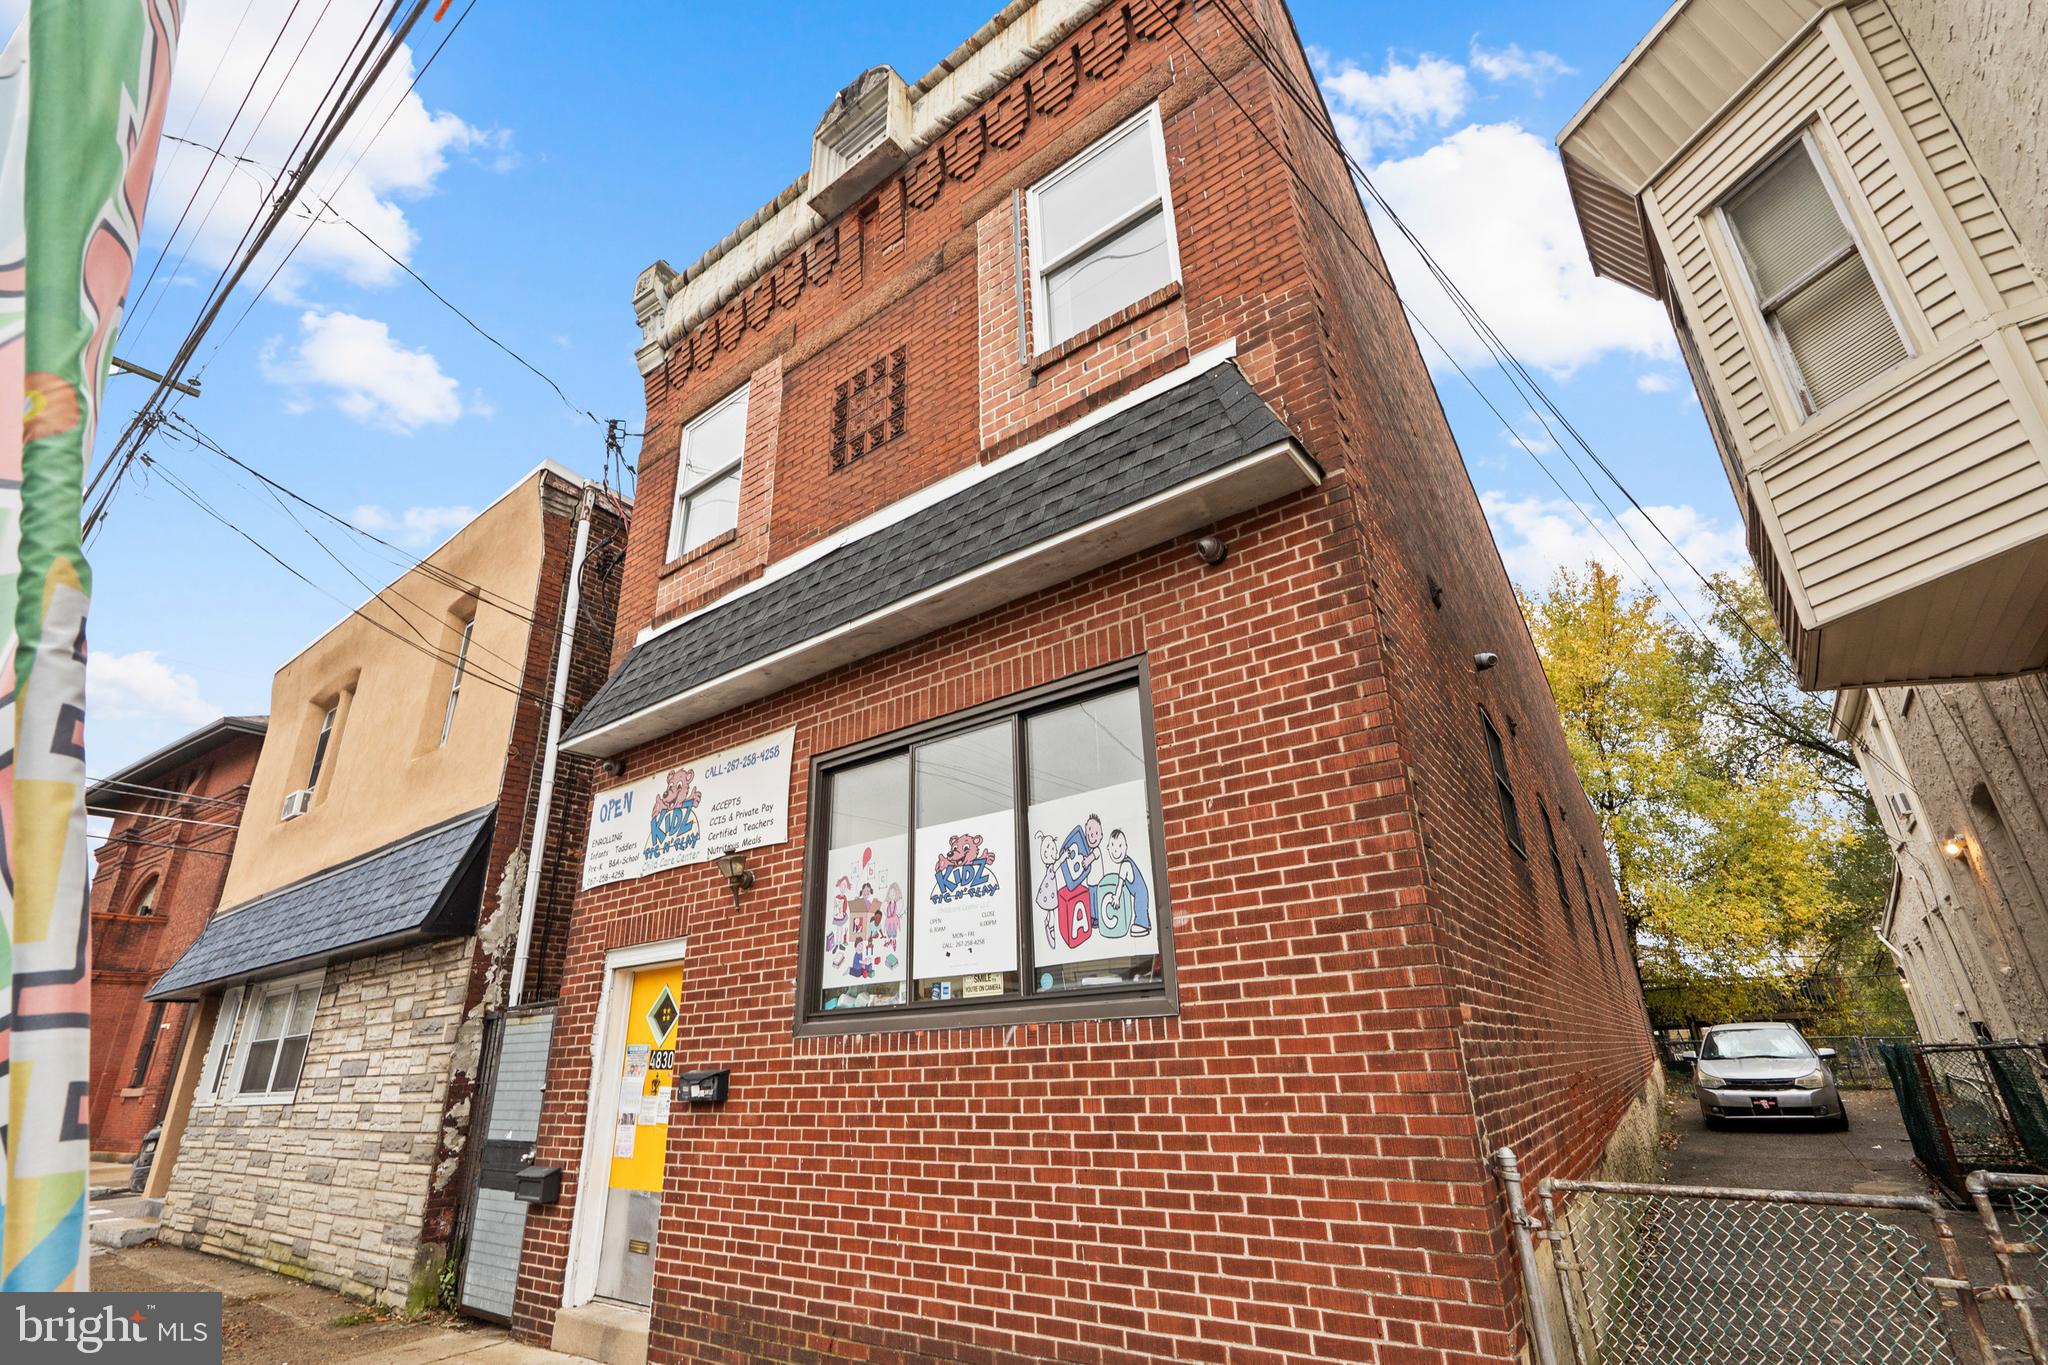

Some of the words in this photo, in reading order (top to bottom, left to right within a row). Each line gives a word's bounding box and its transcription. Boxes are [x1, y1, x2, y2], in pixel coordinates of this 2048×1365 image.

[600, 791, 634, 823] OPEN
[711, 797, 741, 812] ACCEPTS
[650, 800, 694, 846] KIDZ
[709, 814, 726, 827] CCIS
[735, 807, 759, 820] Private
[761, 803, 774, 814] Pay
[708, 826, 738, 841] Certified
[743, 818, 774, 832] Teachers
[592, 832, 623, 848] ENROLLING
[741, 835, 762, 847] Meals
[590, 850, 609, 860] Infants
[615, 842, 637, 853] Toddlers
[935, 858, 989, 894] KIDZ
[973, 974, 991, 983] SMILE
[650, 1050, 674, 1069] 4830
